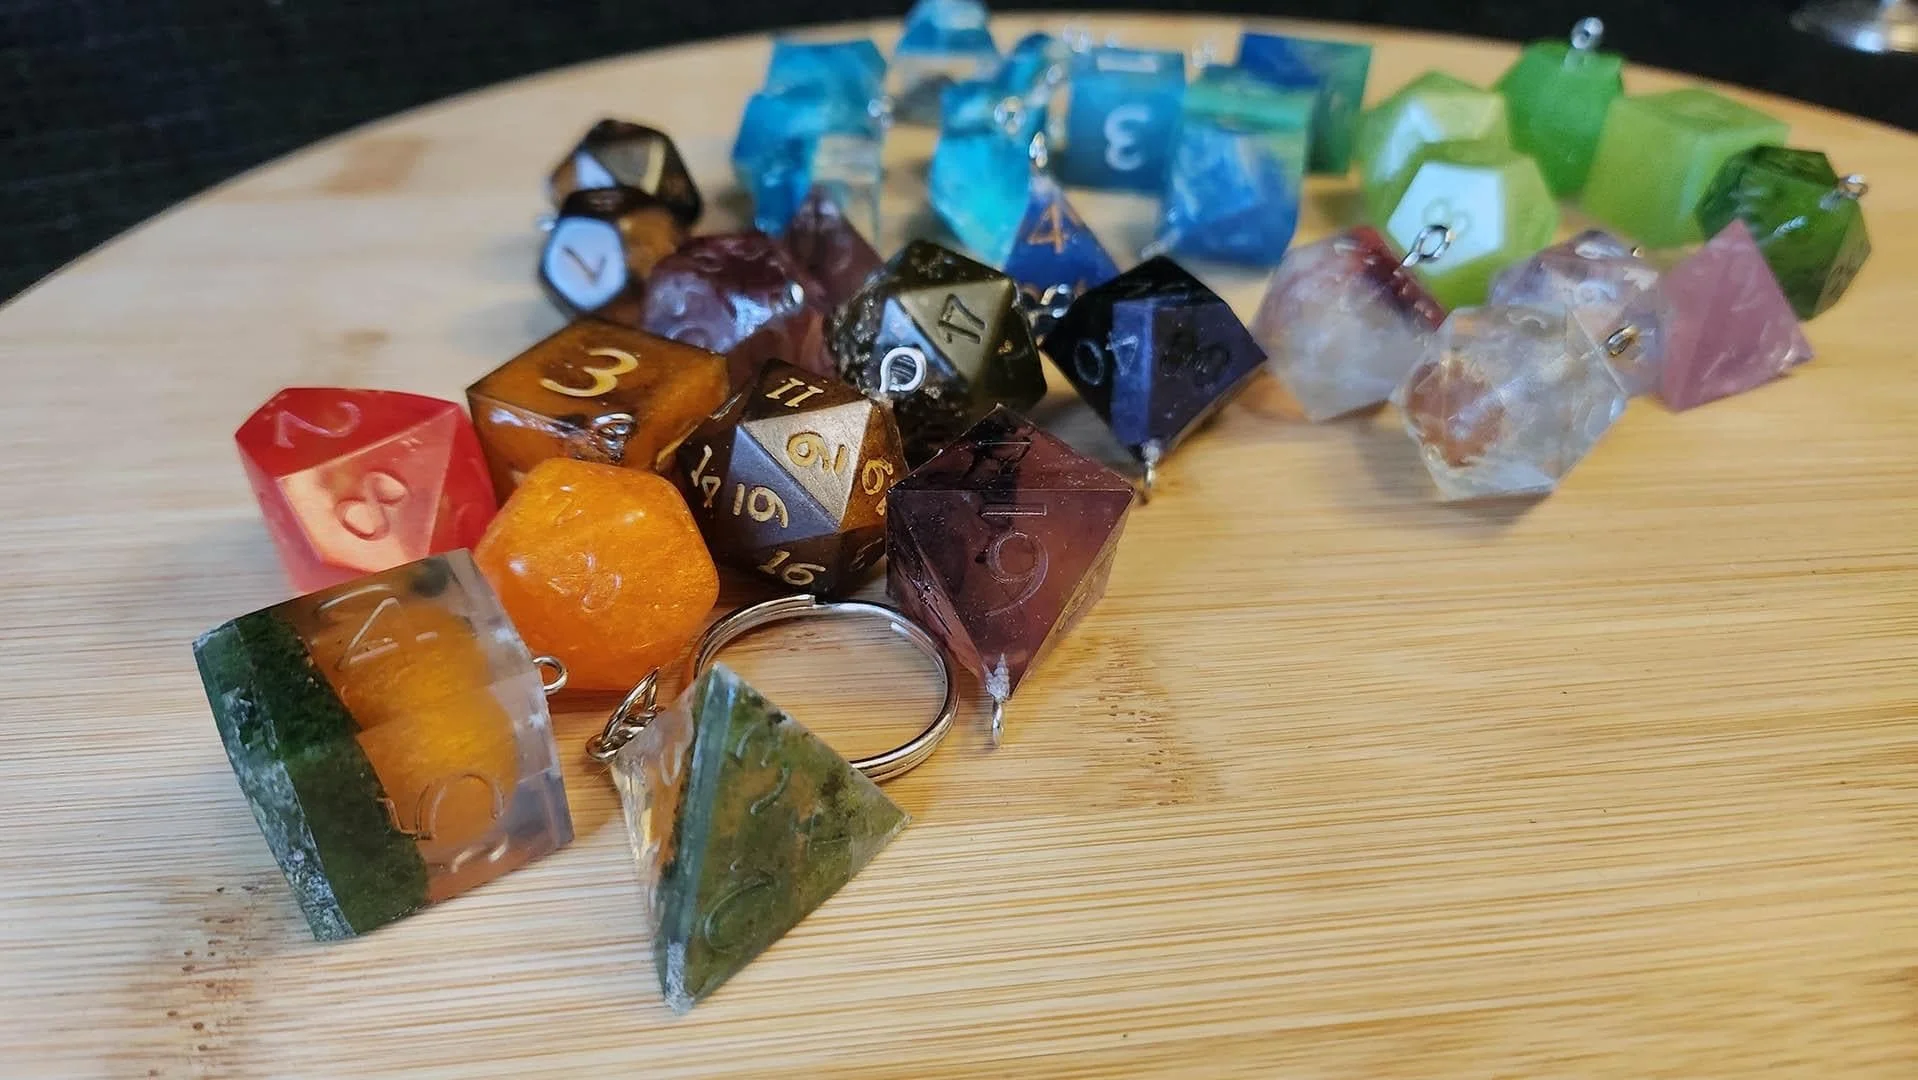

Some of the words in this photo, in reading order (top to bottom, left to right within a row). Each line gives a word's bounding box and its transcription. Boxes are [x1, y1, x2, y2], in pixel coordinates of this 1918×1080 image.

[1026, 200, 1069, 254] 4
[937, 293, 987, 344] 17
[540, 348, 639, 398] 3
[765, 377, 824, 408] 11
[691, 445, 721, 509] 14
[334, 470, 410, 541] 8
[757, 550, 826, 586] 16
